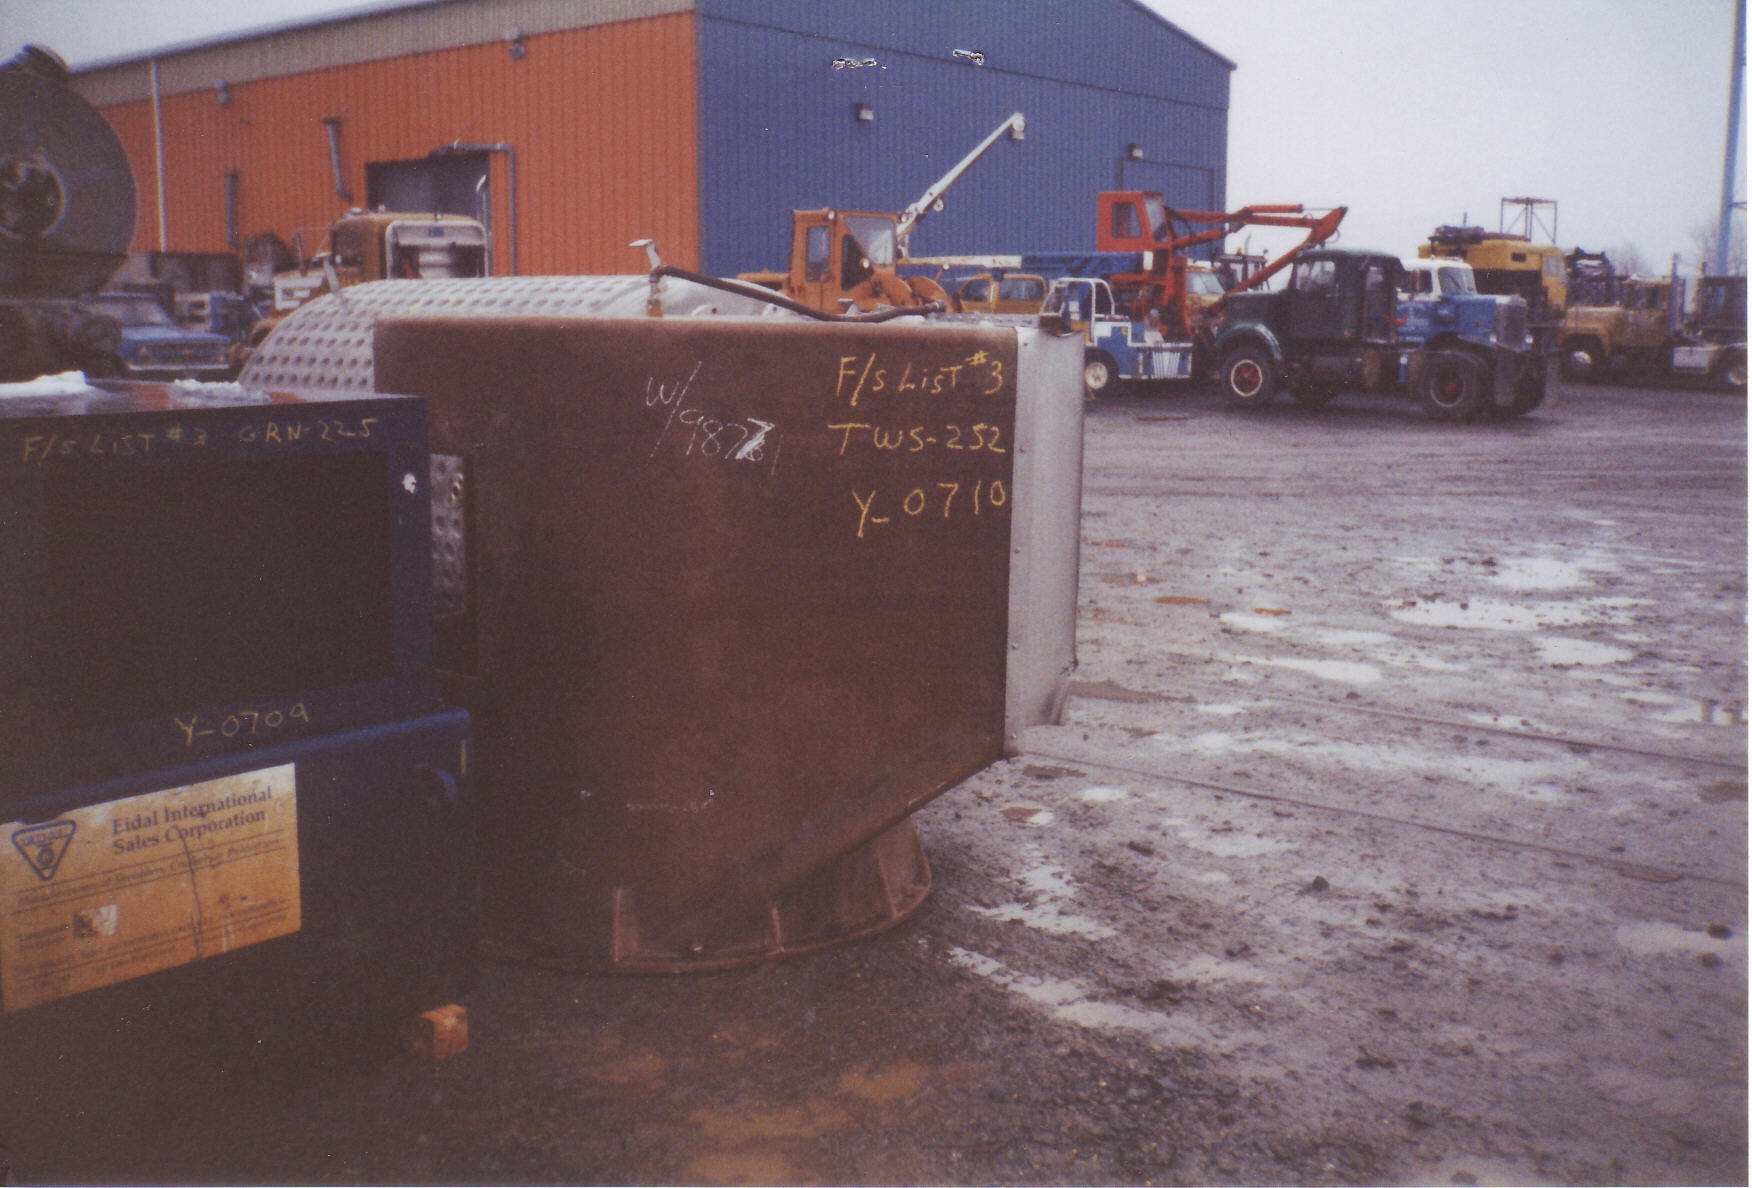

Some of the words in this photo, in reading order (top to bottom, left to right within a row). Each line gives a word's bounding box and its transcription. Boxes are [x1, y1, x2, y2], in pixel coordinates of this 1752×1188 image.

[112, 809, 159, 836] Eidal
[164, 785, 272, 823] International
[113, 828, 160, 856] Sales
[165, 809, 266, 842] Corporation
